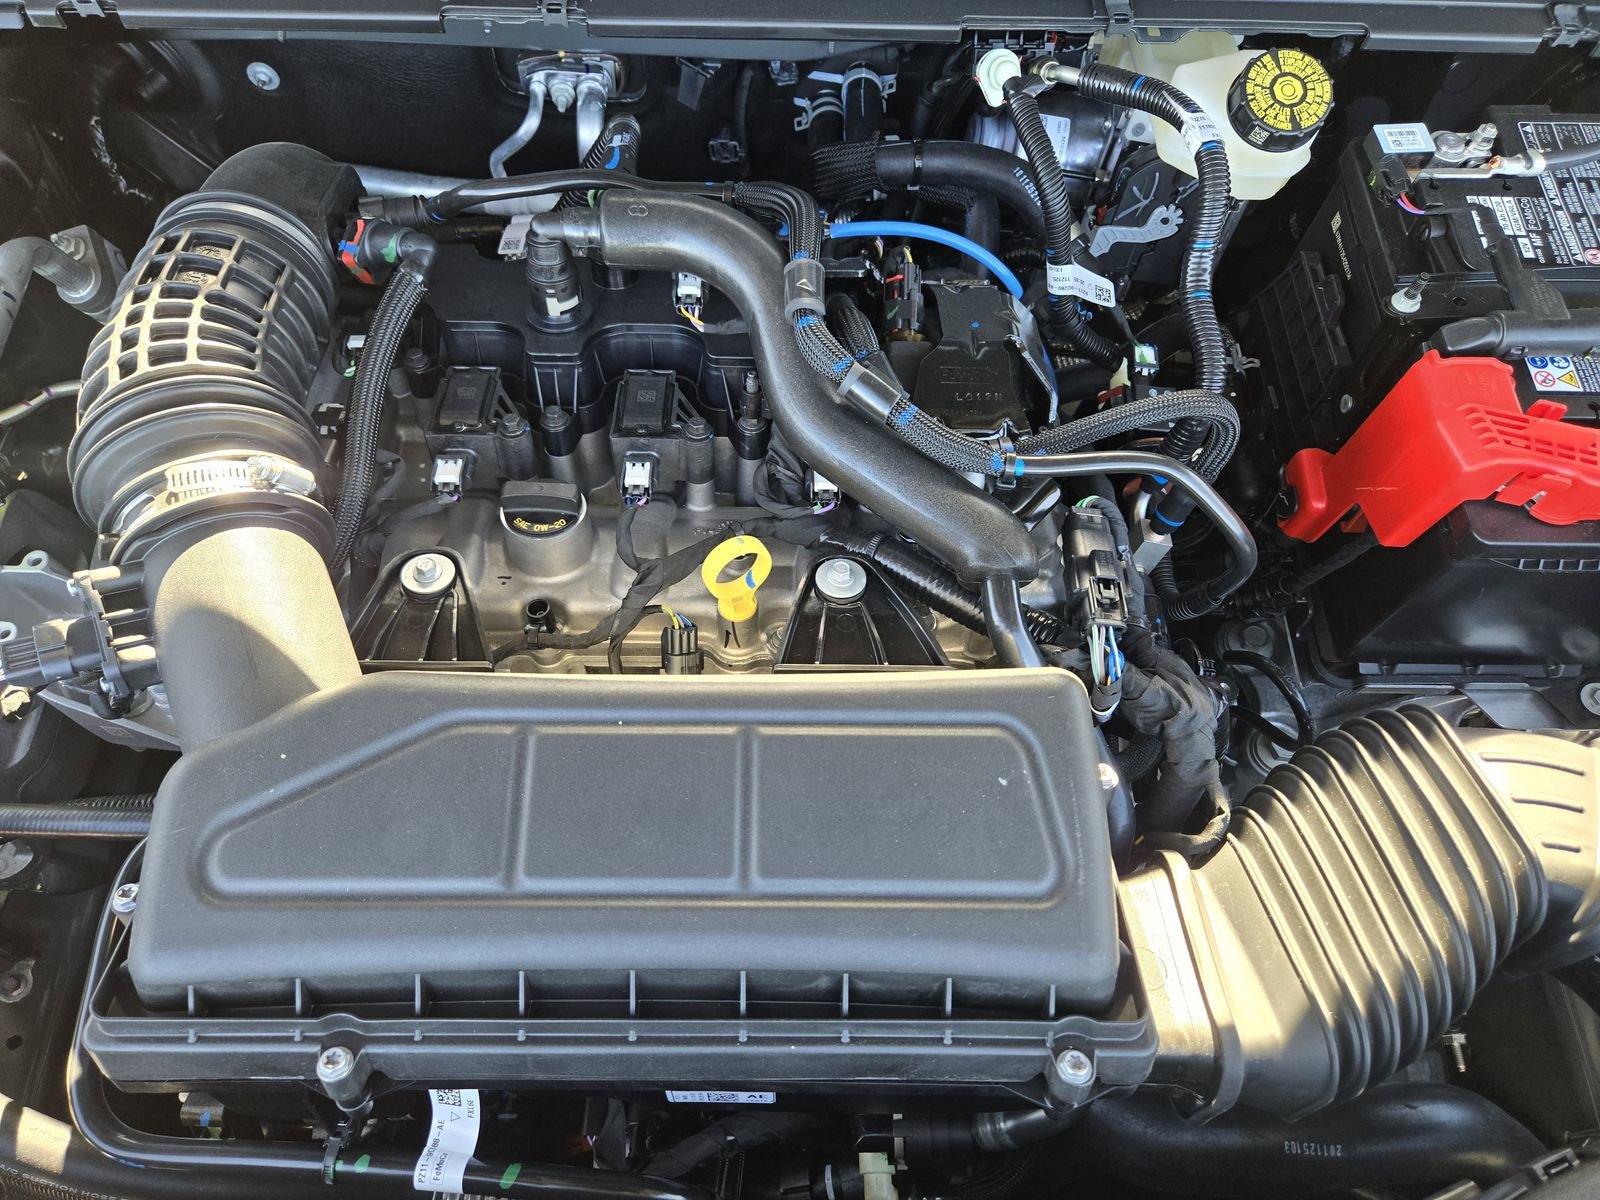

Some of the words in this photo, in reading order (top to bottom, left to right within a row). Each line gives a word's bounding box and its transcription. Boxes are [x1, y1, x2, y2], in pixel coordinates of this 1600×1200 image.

[1263, 118, 1292, 129] CONTAINER
[1521, 198, 1538, 228] FoMoCo
[1529, 232, 1544, 245] MF
[1555, 210, 1581, 253] DANGER/POISON
[1522, 241, 1531, 252] 12V
[513, 517, 531, 530] SAE
[533, 518, 567, 532] 0W-20
[22, 1172, 78, 1194] SUCTION
[81, 1189, 117, 1200] HOSE
